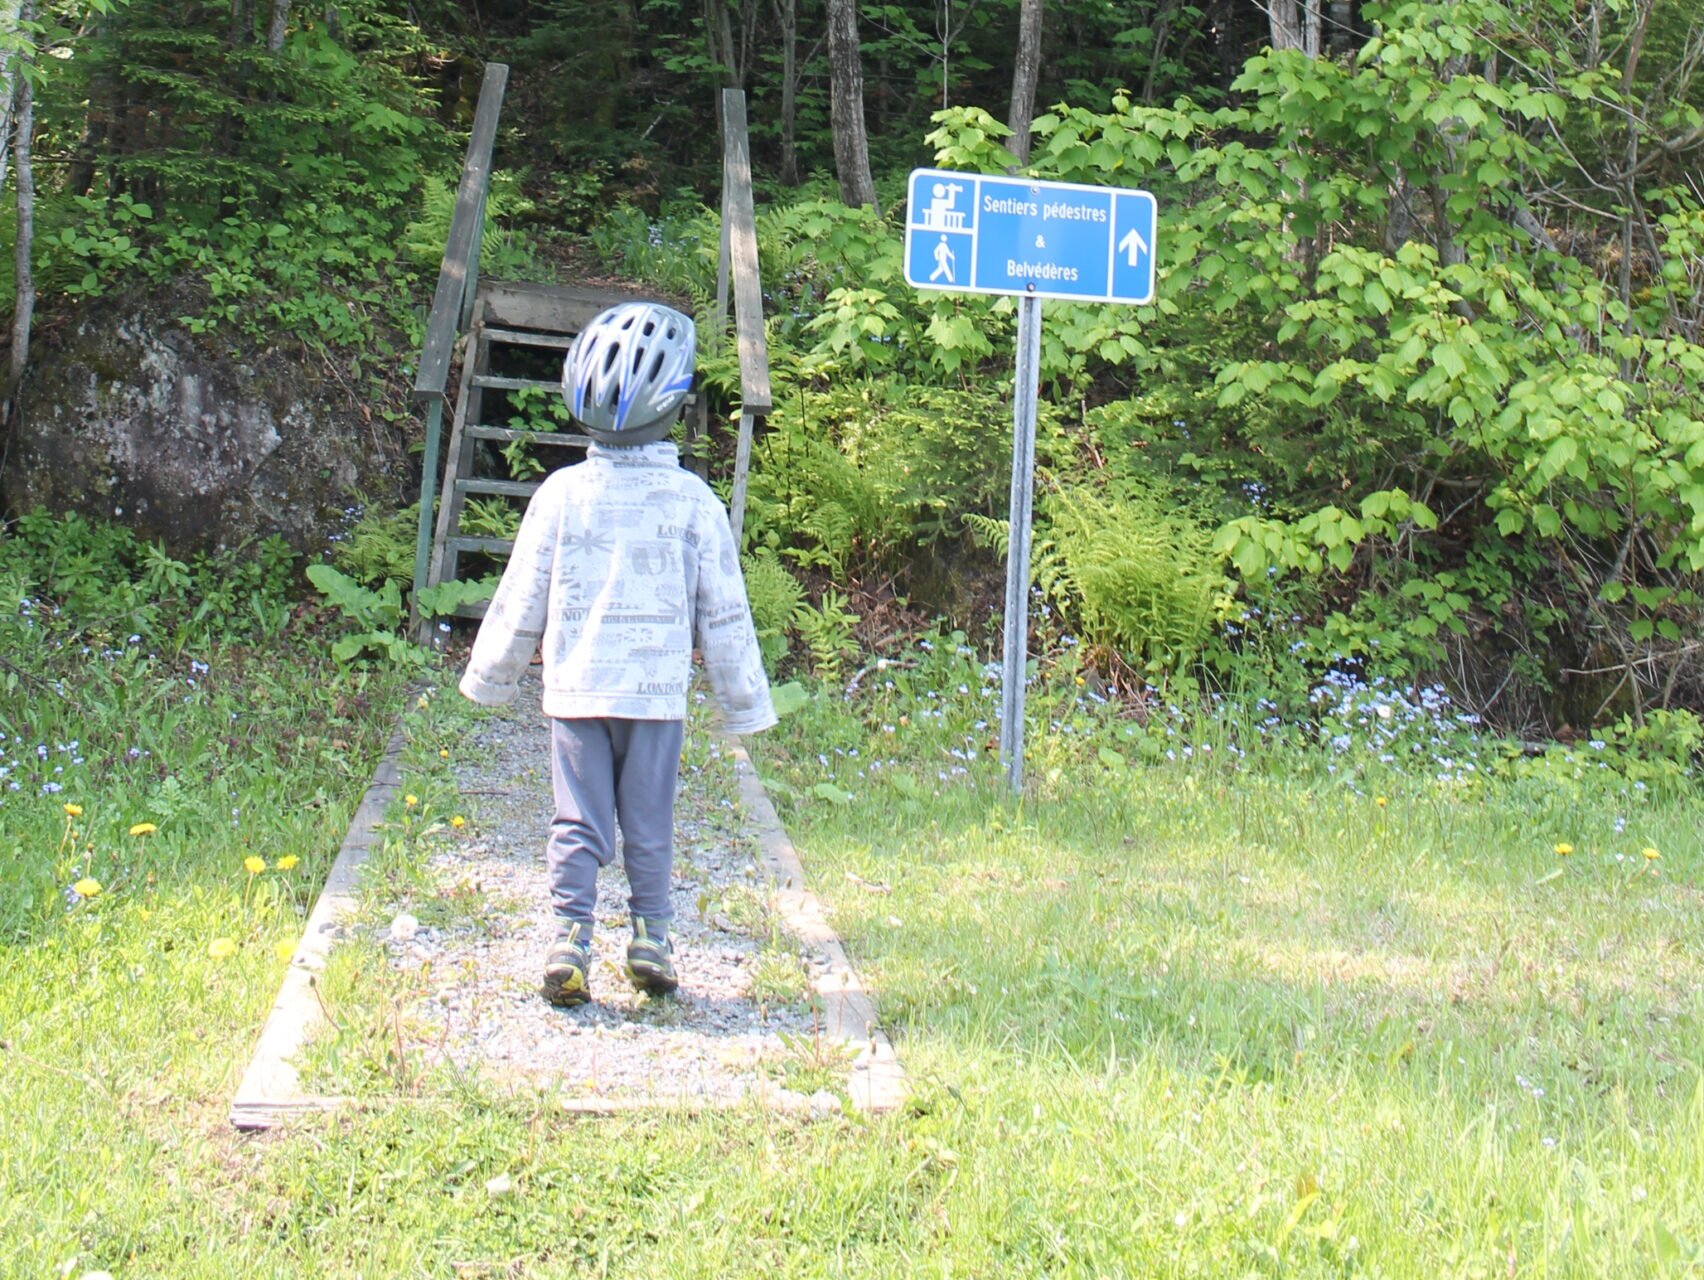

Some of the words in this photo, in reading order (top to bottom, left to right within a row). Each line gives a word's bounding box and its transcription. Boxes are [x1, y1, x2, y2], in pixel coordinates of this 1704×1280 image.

[983, 195, 1038, 217] Sentiers
[1043, 202, 1106, 222] pédestres
[1035, 234, 1045, 248] &
[1007, 259, 1078, 281] Belvédères
[656, 524, 701, 549] LODON
